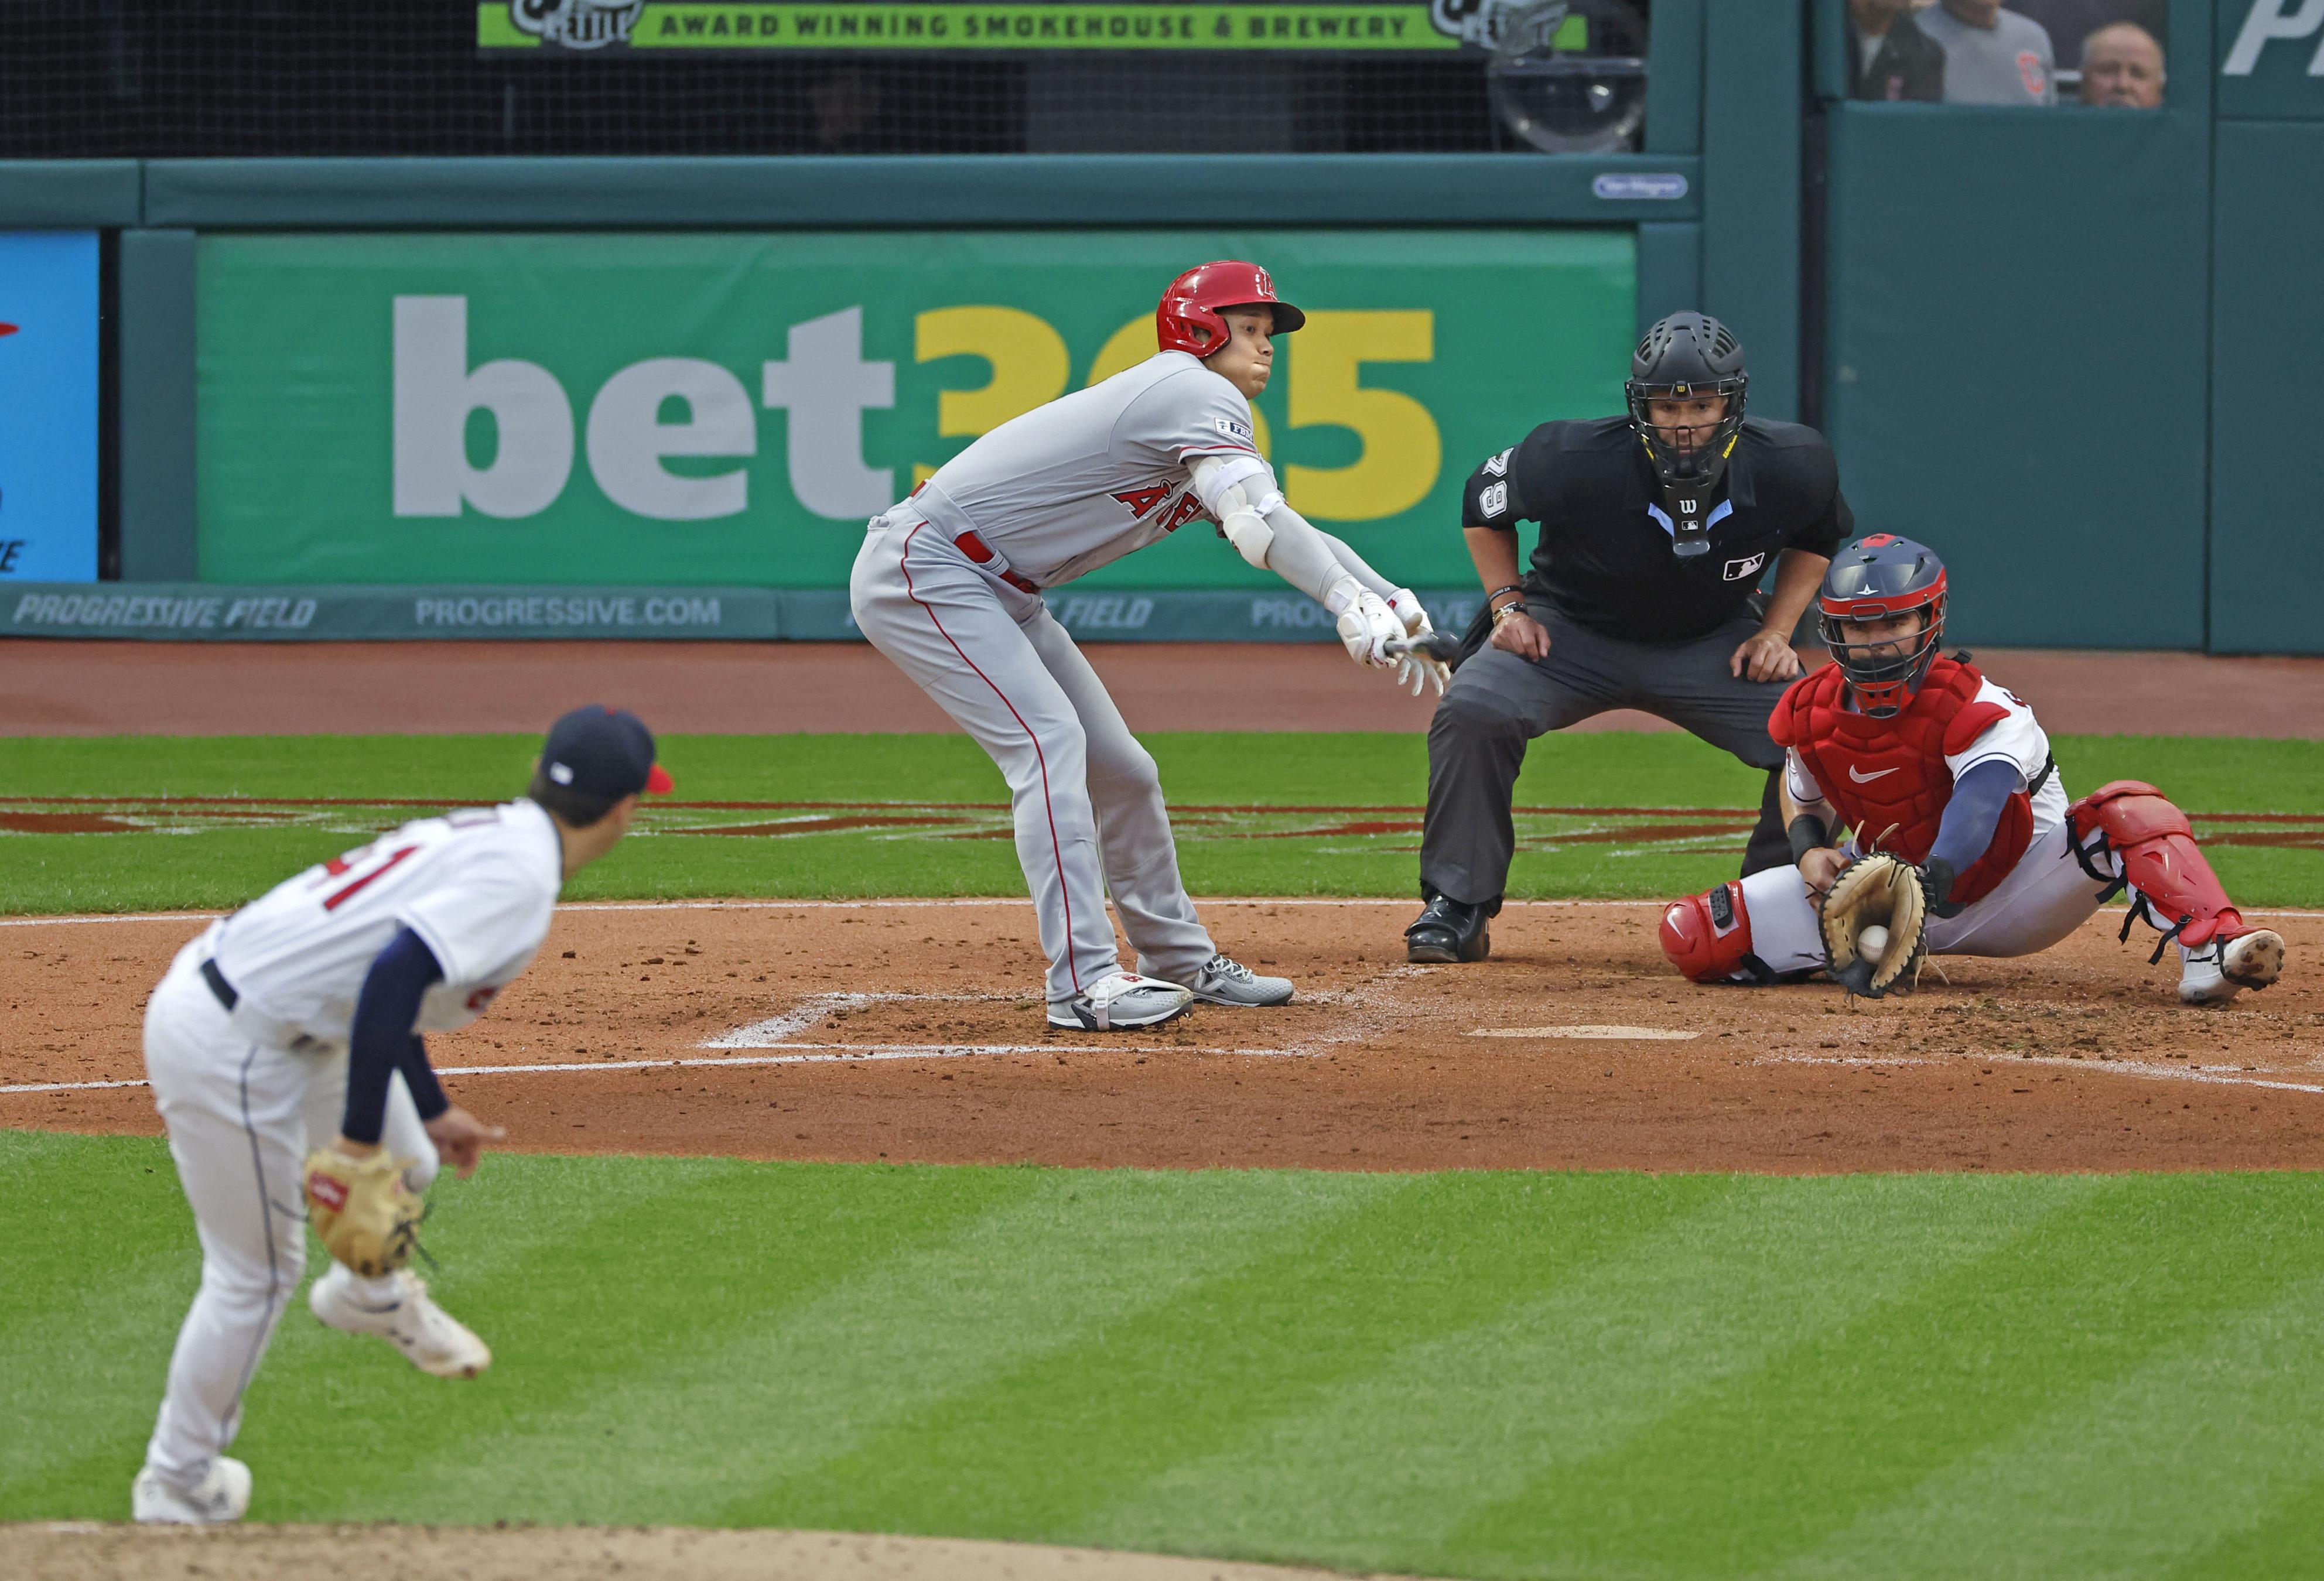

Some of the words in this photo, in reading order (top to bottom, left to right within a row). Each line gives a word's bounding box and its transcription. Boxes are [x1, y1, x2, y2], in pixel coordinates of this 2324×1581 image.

[659, 15, 779, 36] AWARD
[795, 15, 948, 37] WINNING
[963, 15, 1192, 37] SMOKEHOUSE
[1214, 15, 1231, 37] &
[1248, 16, 1407, 37] BREWERY
[1479, 447, 1515, 519] 79
[13, 594, 221, 628] PROGRESSIVE
[225, 598, 317, 628] FIELD
[415, 597, 721, 626] PROGRESSIVE.COM
[1061, 597, 1154, 628] FIELD
